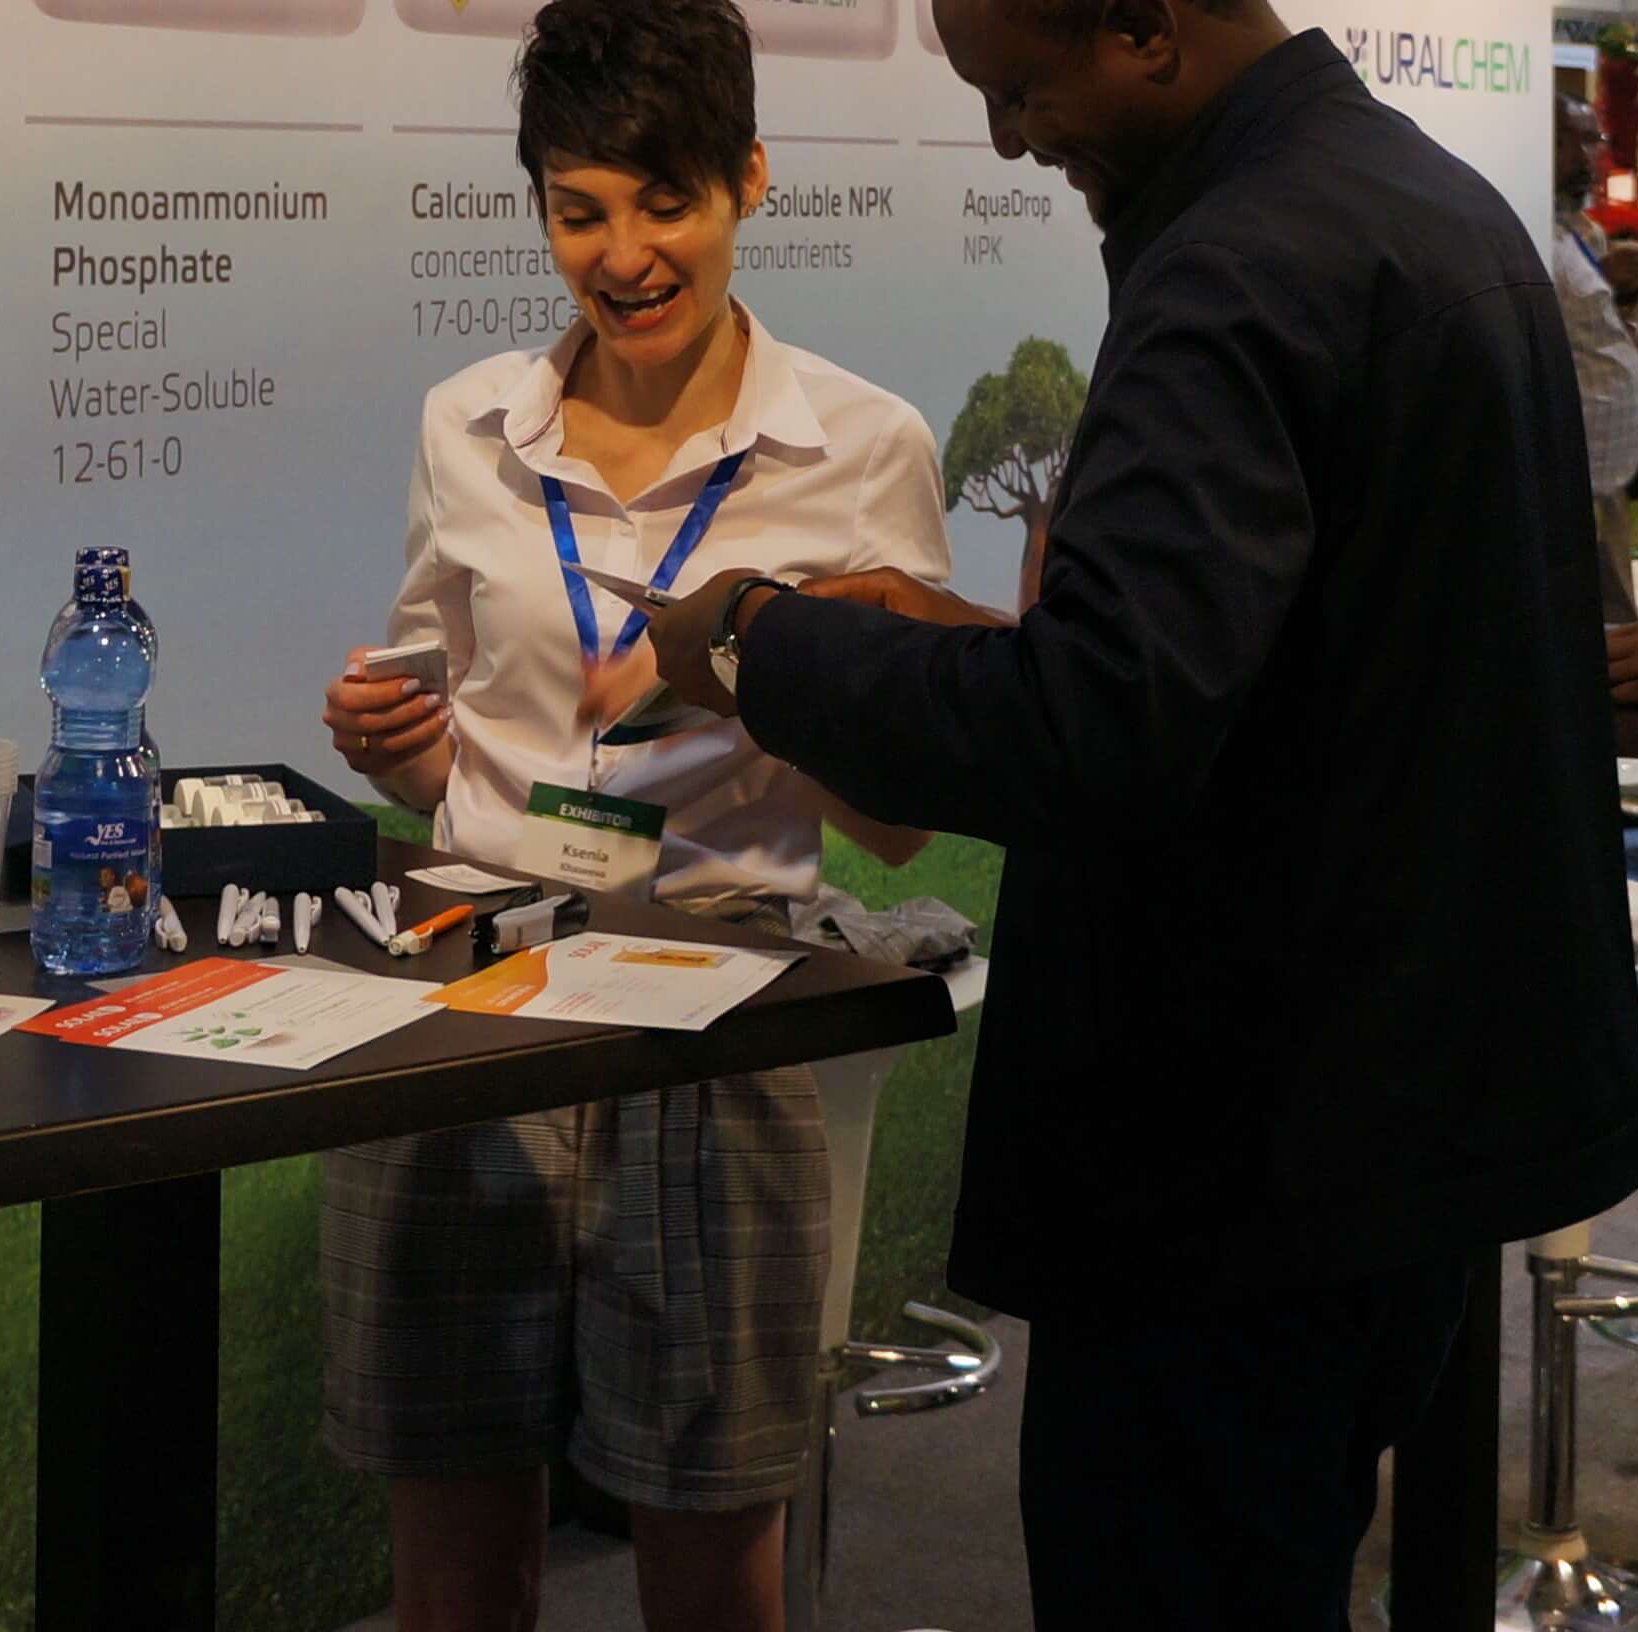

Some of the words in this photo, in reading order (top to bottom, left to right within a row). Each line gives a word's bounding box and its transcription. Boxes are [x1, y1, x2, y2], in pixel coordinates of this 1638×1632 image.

[1374, 30, 1531, 95] URALCHEM
[53, 181, 330, 223] Monoammonium
[411, 181, 515, 219] Calcium
[759, 185, 841, 218] -Soluble
[848, 186, 894, 218] NPK
[962, 188, 1052, 224] AquaDrop
[410, 245, 557, 279] concentrat
[734, 237, 852, 271] cronutrients
[962, 235, 1004, 266] NPK
[52, 246, 233, 296] Phosphate
[51, 310, 167, 362] Special
[412, 296, 580, 345] 17-0-0-(33Ca
[50, 369, 276, 421] Water-Soluble
[51, 436, 182, 486] 12-61-0
[84, 821, 125, 847] YES
[558, 803, 633, 829] EXHIBITOR
[561, 843, 610, 863] Ksenia
